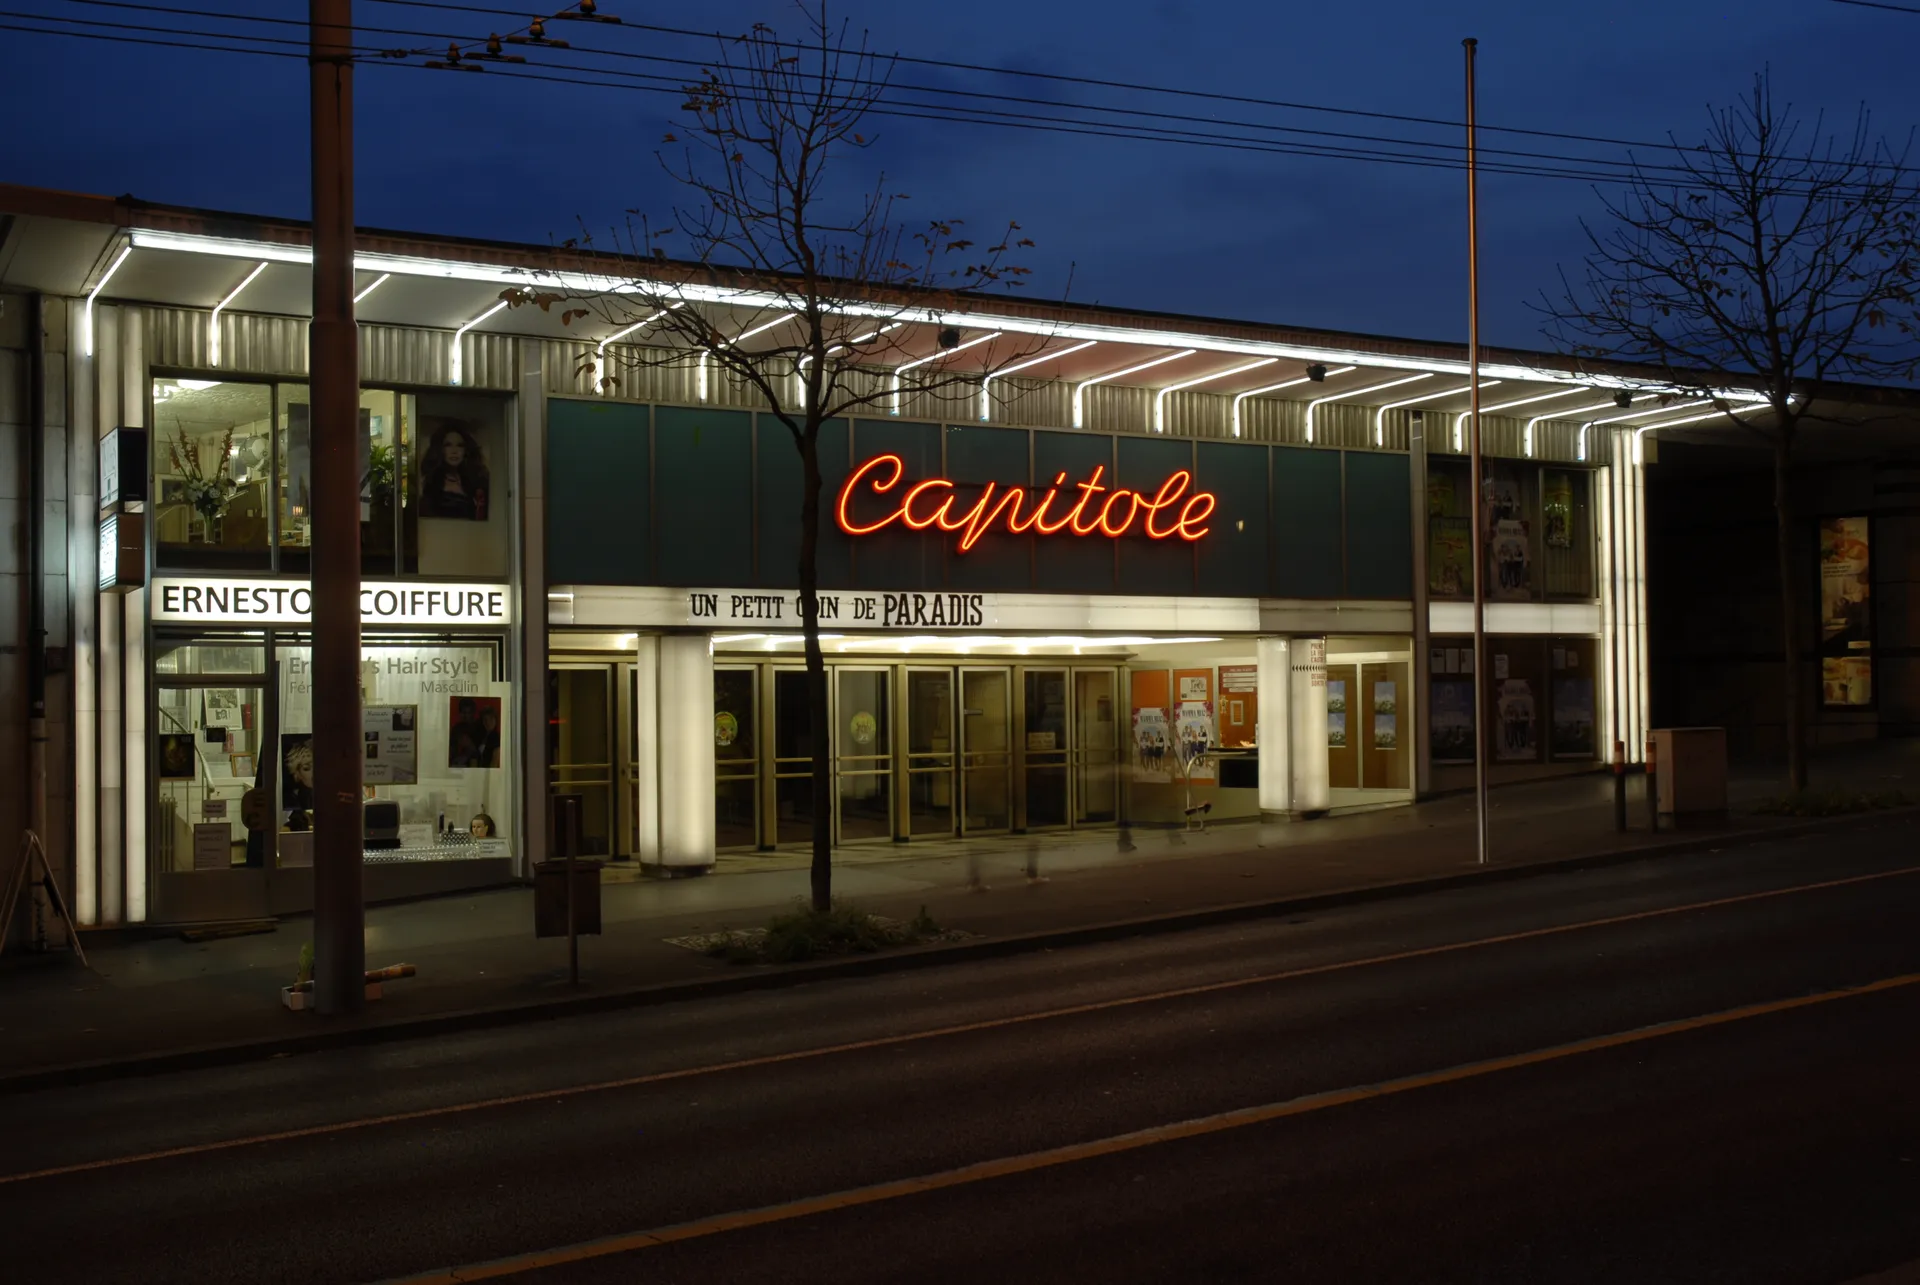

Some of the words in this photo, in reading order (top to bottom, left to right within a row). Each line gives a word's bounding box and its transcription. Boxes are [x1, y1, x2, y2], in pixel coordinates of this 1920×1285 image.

[837, 453, 1216, 552] Capitole
[163, 585, 312, 615] ERNESTO
[360, 590, 503, 617] COIFFURE
[691, 594, 718, 617] UN
[731, 595, 785, 619] PETIT
[853, 597, 876, 620] DE
[883, 593, 983, 627] PARADIS
[387, 656, 427, 675] Hair
[431, 656, 479, 679] Style
[421, 680, 479, 693] Masculin
